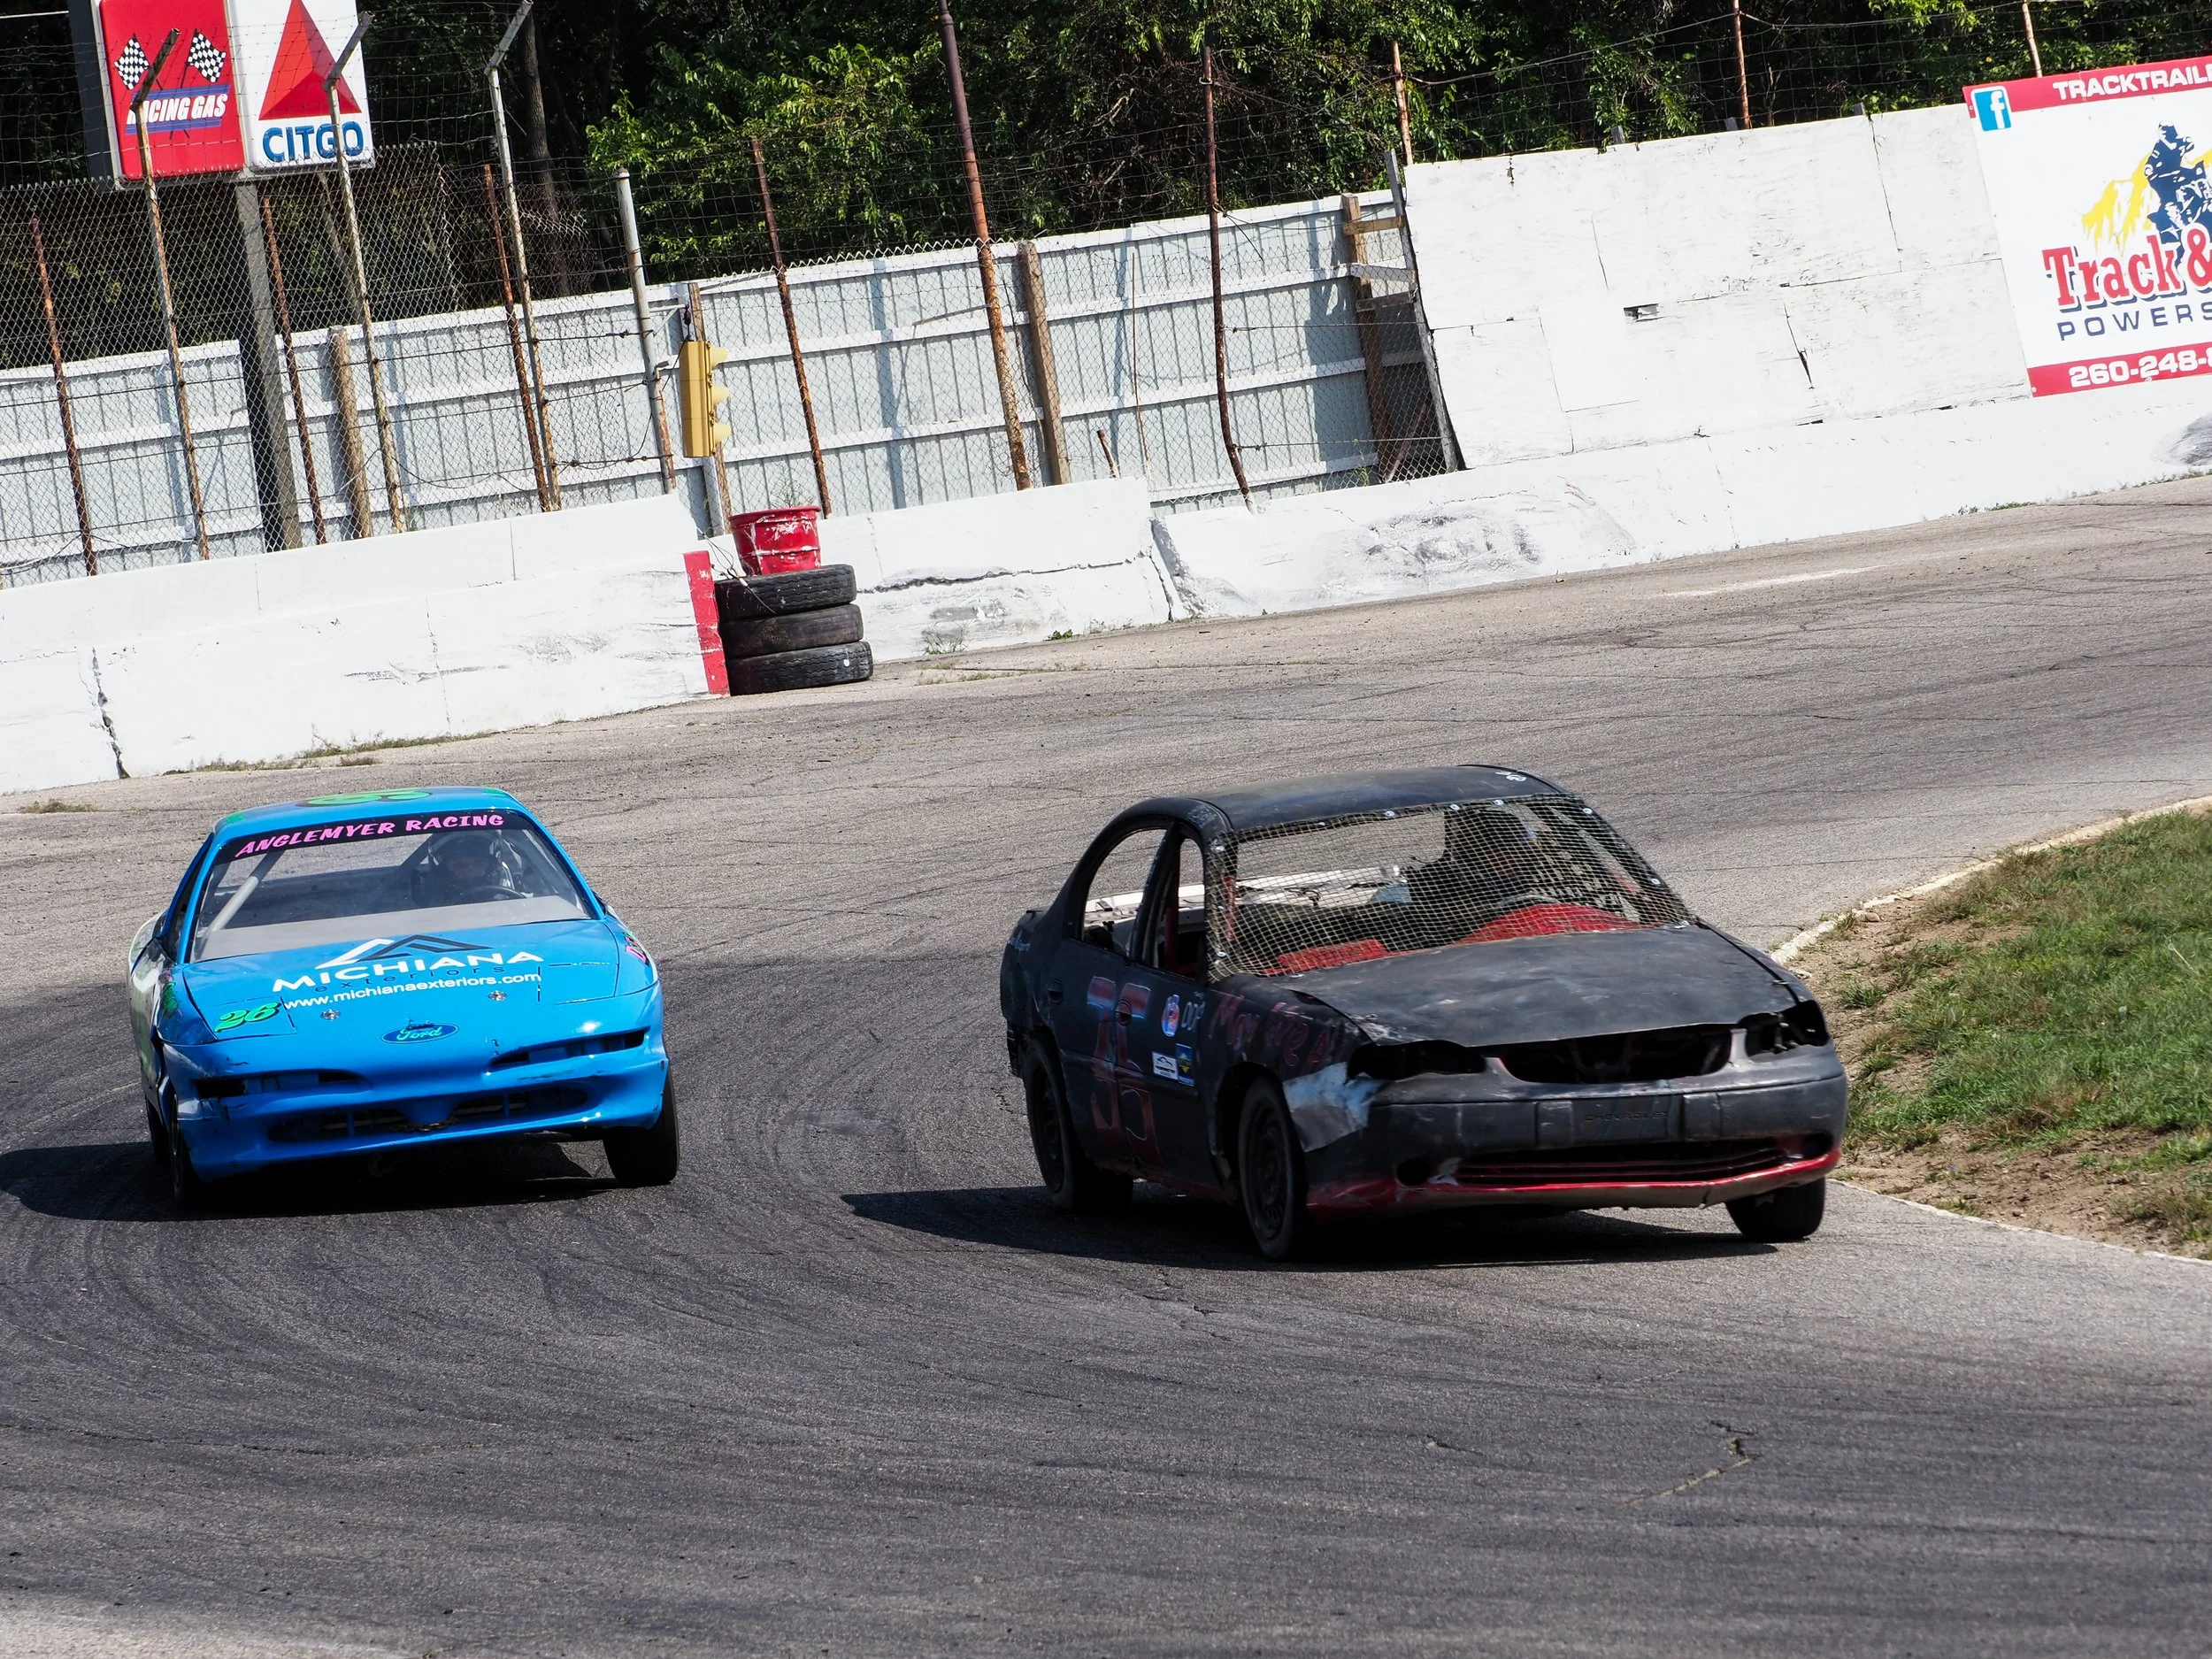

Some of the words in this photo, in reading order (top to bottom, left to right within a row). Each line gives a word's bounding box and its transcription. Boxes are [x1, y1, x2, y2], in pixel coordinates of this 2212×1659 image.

[191, 94, 228, 119] GAS
[263, 120, 365, 162] CITGO
[2042, 234, 2185, 308] Track
[234, 822, 396, 857] ANGLEMYER
[405, 814, 504, 833] RACING
[272, 951, 544, 993] MICHIANA
[284, 972, 542, 1010] www.michianaexteriors.com
[314, 966, 505, 993] exteriors
[213, 1002, 282, 1033] 26
[396, 1026, 443, 1041] Ford
